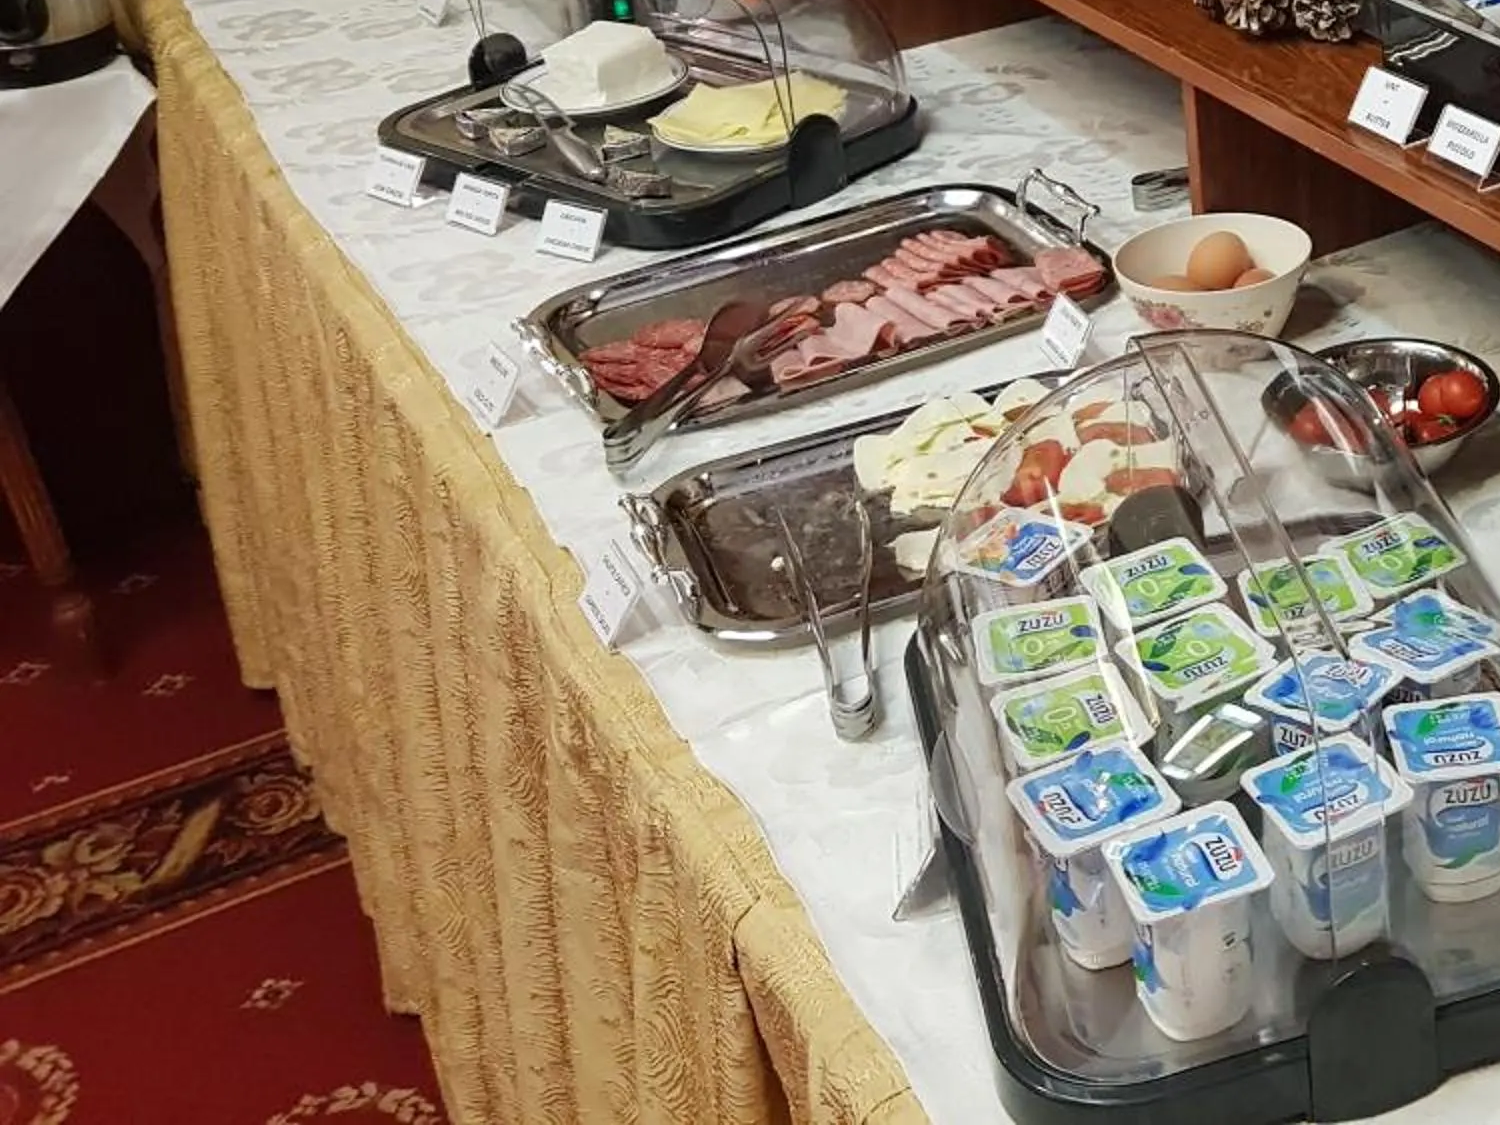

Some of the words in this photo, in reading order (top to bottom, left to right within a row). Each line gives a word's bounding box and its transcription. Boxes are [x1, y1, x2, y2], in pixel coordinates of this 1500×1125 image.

[1124, 555, 1168, 578] ZUZU
[1018, 613, 1065, 633] ZUZU
[1182, 655, 1229, 680] ZUZU
[1086, 693, 1117, 725] ZUZU
[1432, 749, 1483, 765] ZUZU
[1443, 782, 1492, 804] ZUZU
[1204, 835, 1239, 874] ZUZU
[1330, 839, 1374, 869] ZUZU
